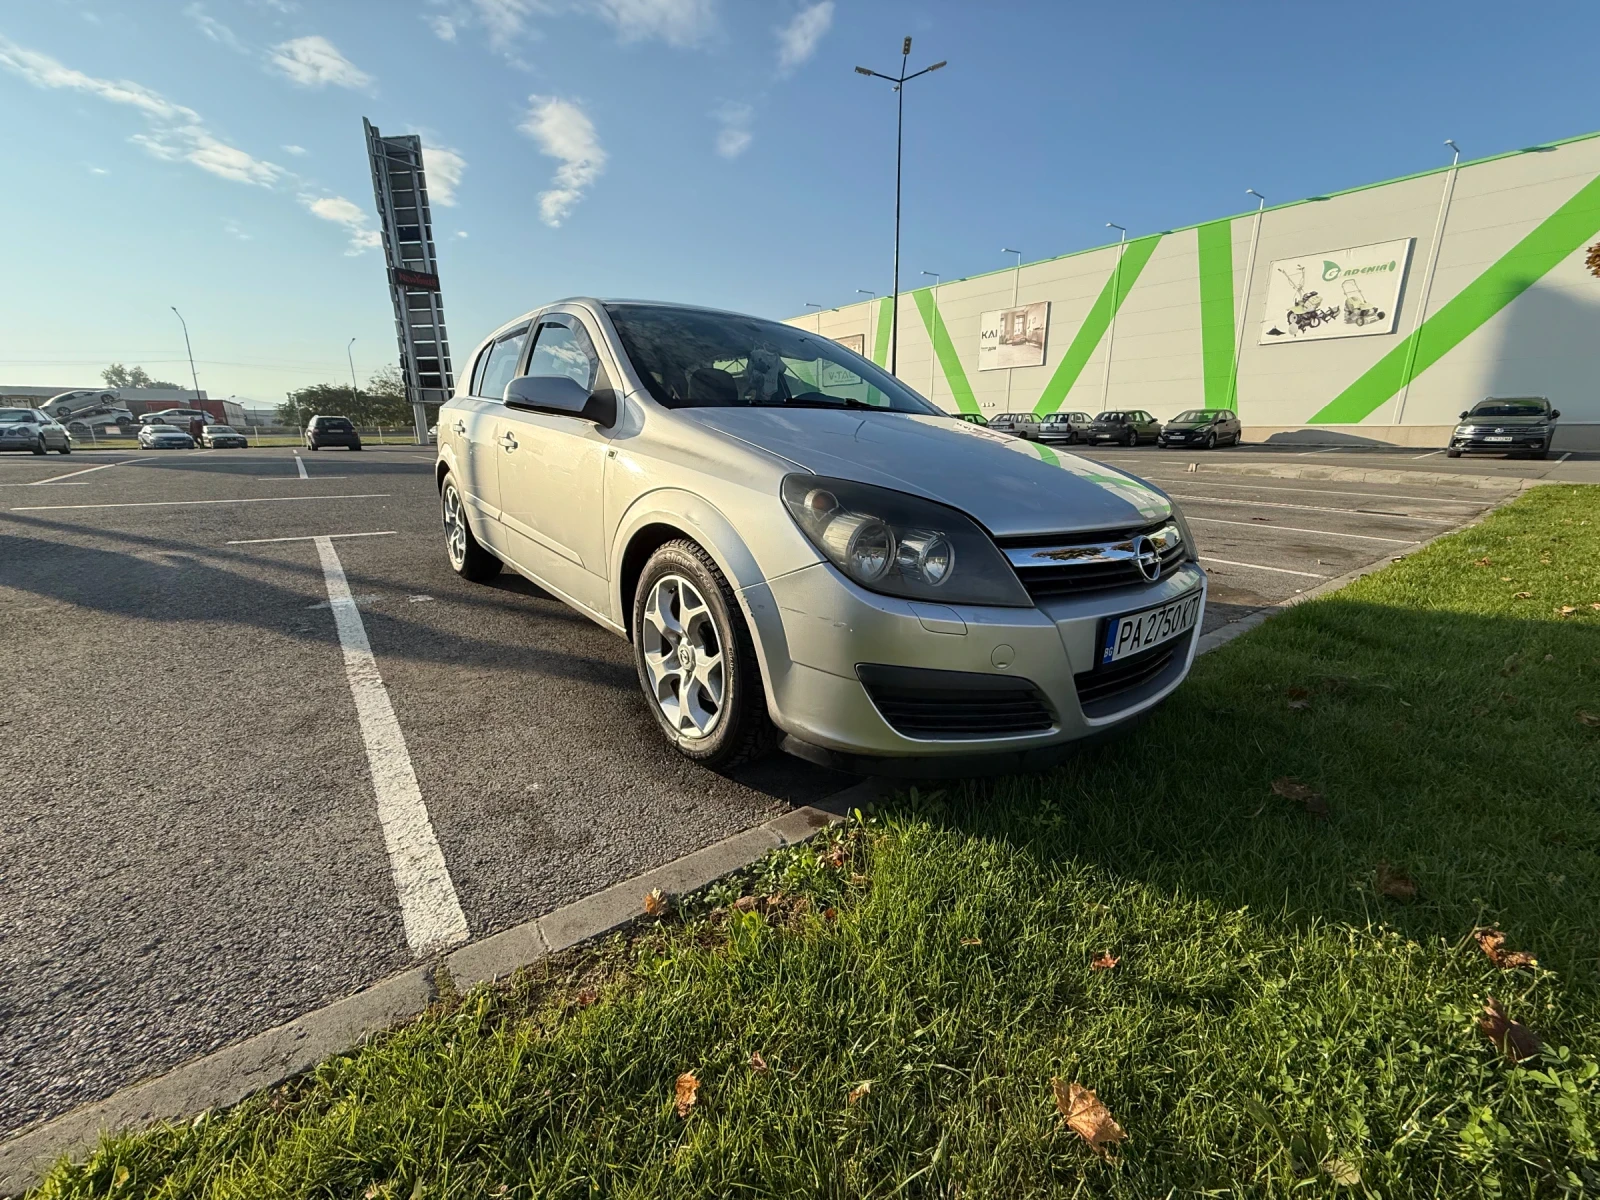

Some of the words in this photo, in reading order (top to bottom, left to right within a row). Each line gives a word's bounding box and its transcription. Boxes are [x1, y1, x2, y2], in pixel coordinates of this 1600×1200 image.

[981, 329, 998, 340] KAI
[1117, 617, 1142, 654] PA
[1143, 604, 1181, 645] 2750
[1179, 595, 1198, 629] KT
[1103, 646, 1114, 658] BG
